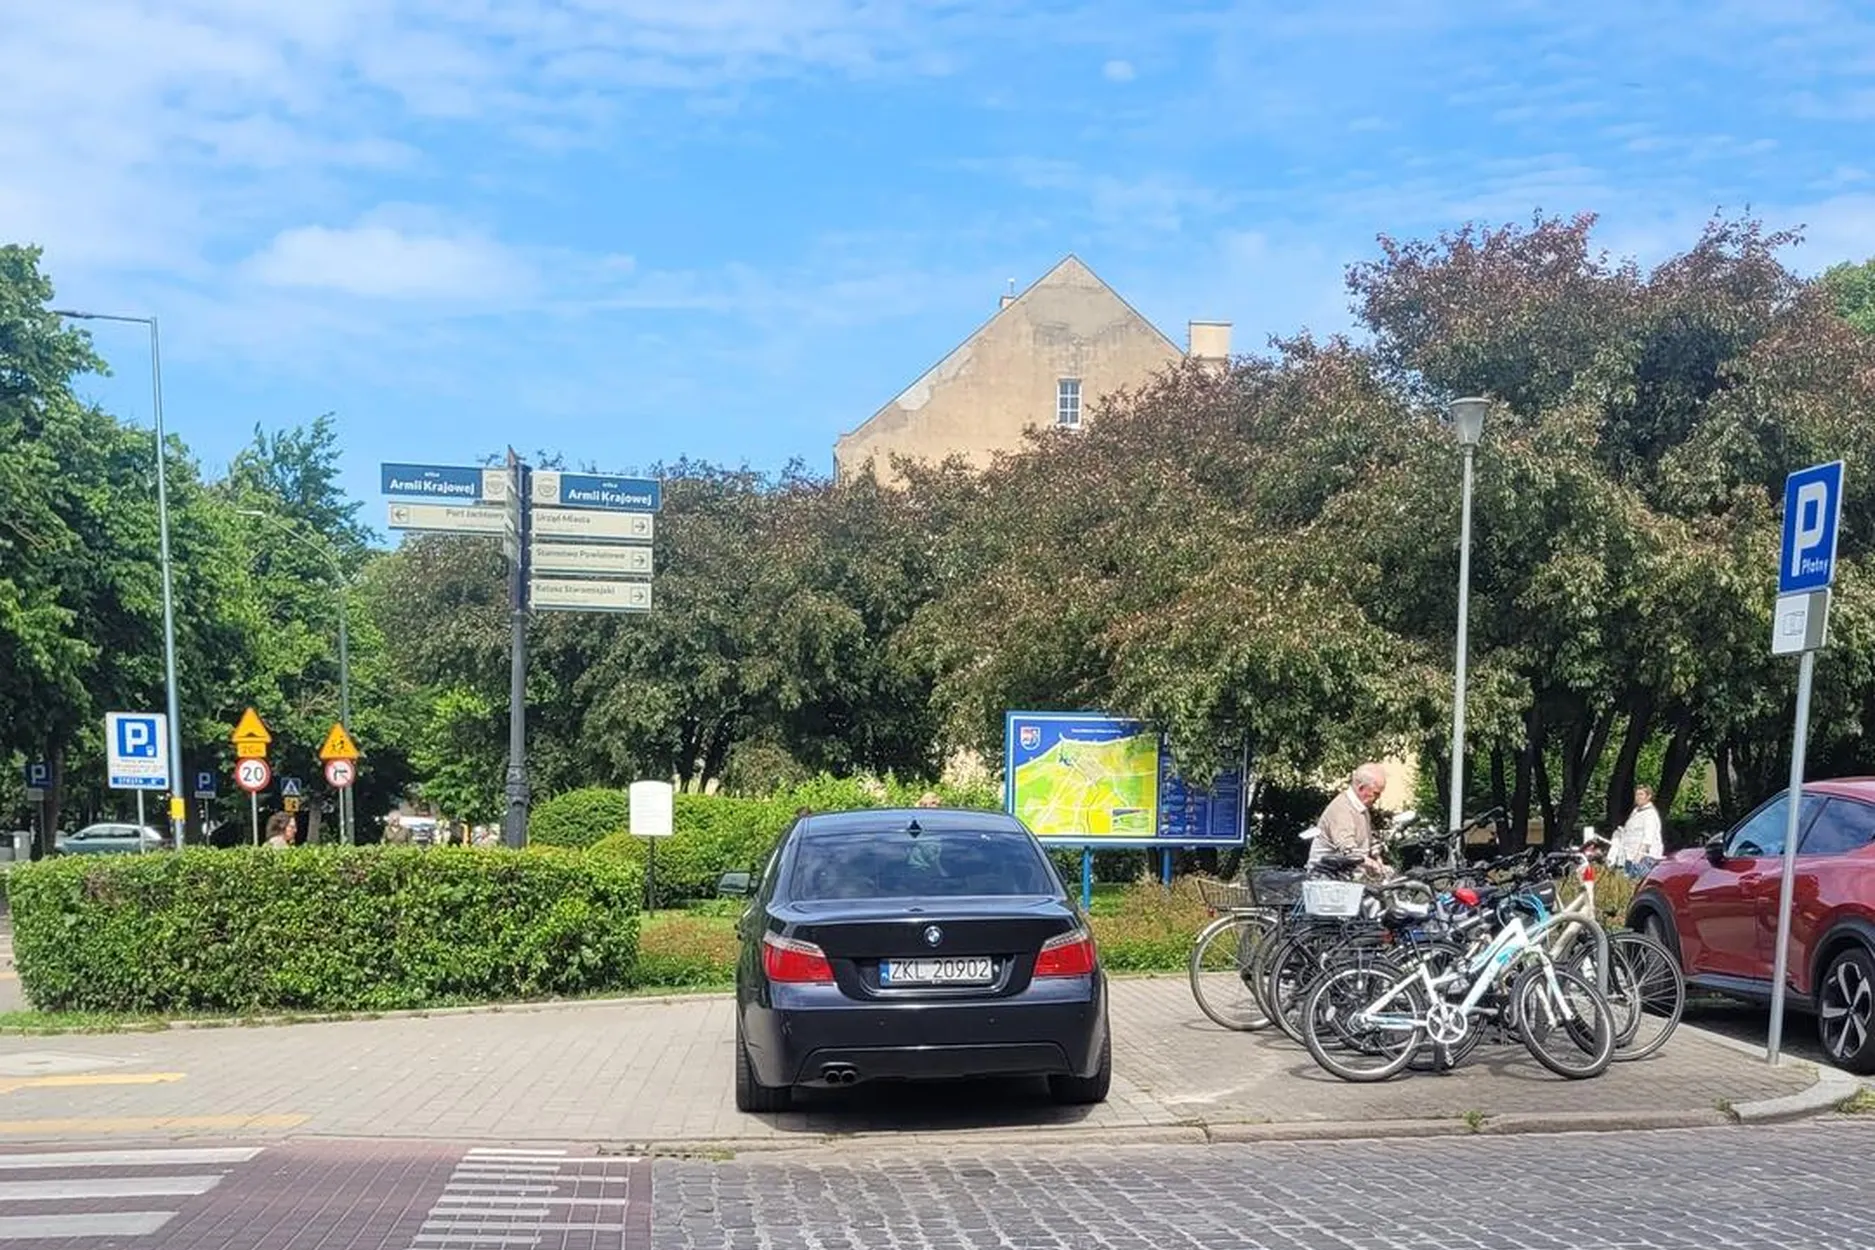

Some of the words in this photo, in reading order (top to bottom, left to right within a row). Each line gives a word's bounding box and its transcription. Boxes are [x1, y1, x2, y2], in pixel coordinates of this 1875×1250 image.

[390, 479, 422, 491] Armii
[423, 480, 475, 495] Krajowej
[568, 489, 600, 501] Armii
[601, 491, 652, 506] Krajowej
[1791, 481, 1828, 577] P
[125, 722, 148, 754] P
[242, 766, 265, 783] 20
[891, 960, 925, 980] ZKL
[932, 959, 990, 979] 20902
